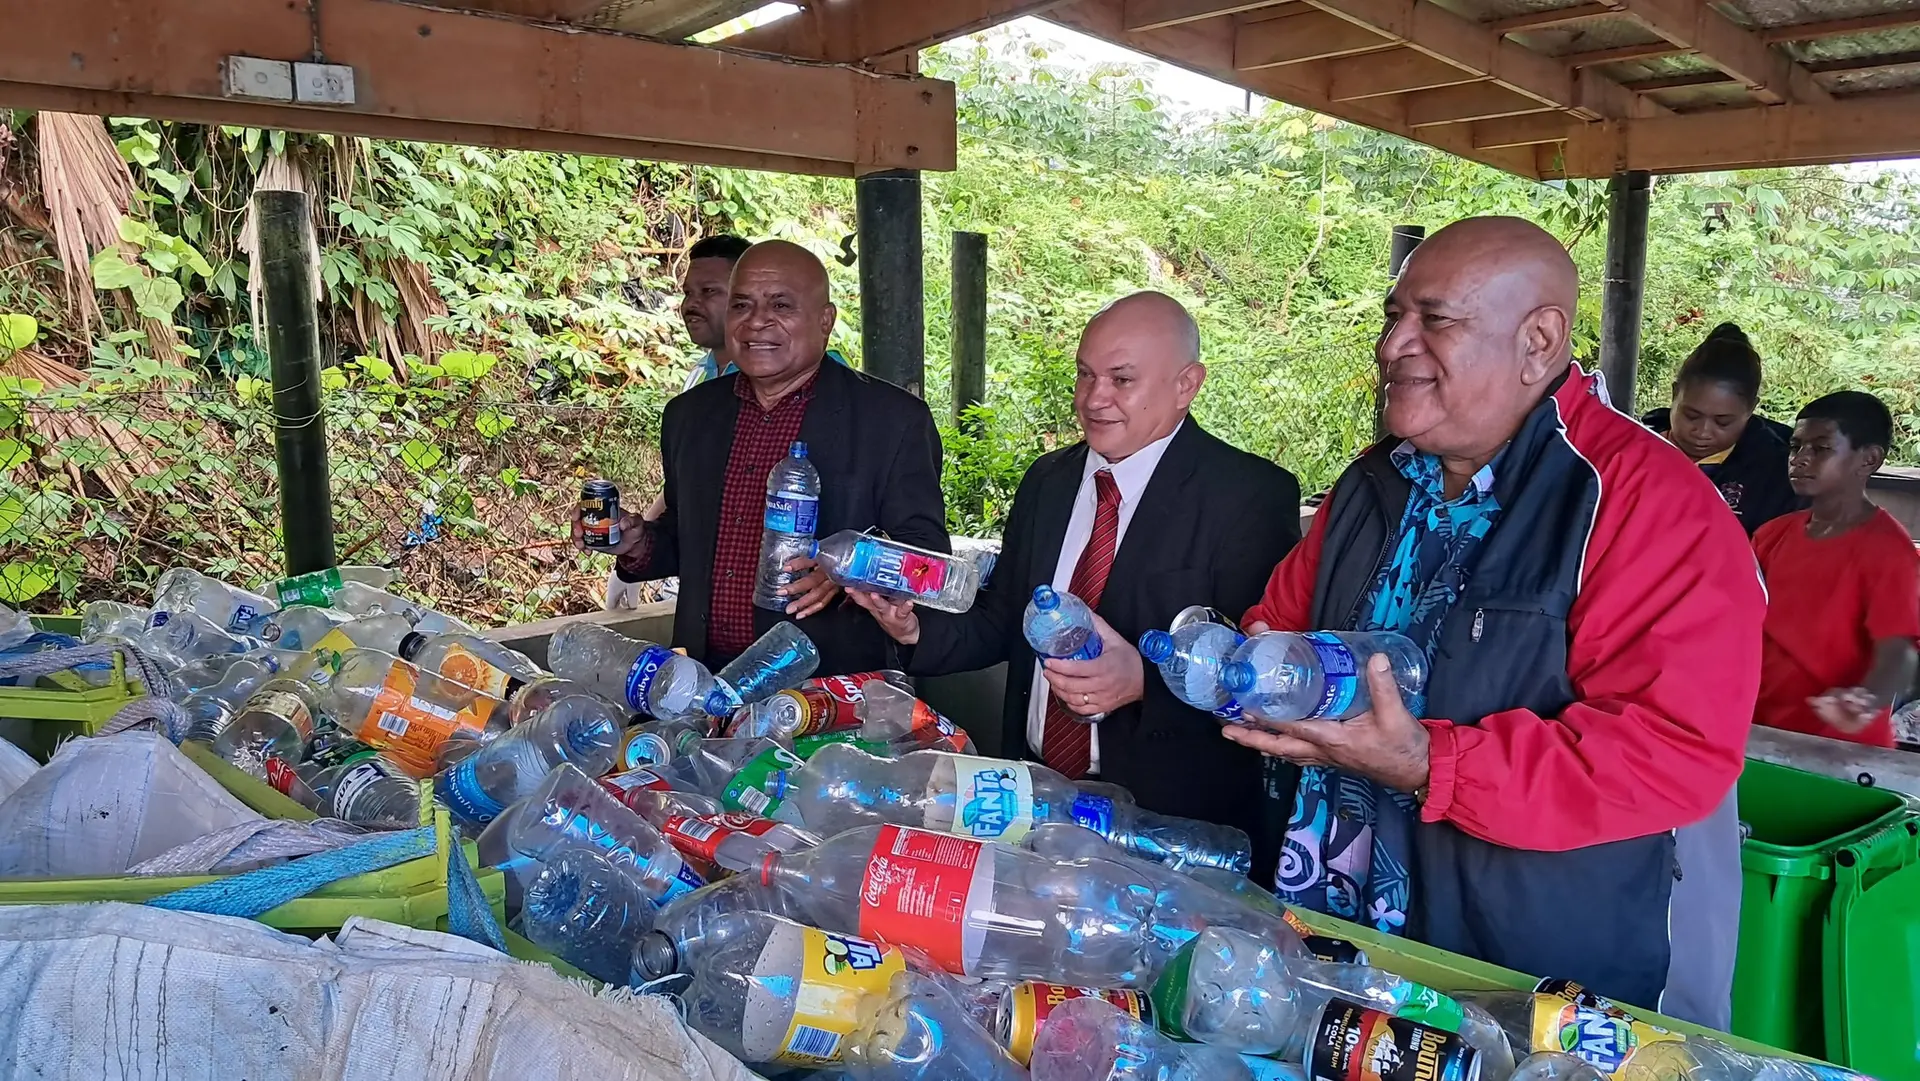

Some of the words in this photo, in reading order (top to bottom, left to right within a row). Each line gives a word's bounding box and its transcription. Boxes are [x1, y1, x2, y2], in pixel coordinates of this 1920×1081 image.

[876, 550, 904, 585] FIJI
[972, 769, 1001, 837] FANTA
[1338, 1008, 1354, 1036] PREMIUM
[1327, 1024, 1339, 1046] COLA
[1335, 1035, 1344, 1051] FIJI
[1410, 1027, 1422, 1051] STRONG
[1331, 1051, 1340, 1069] RUM
